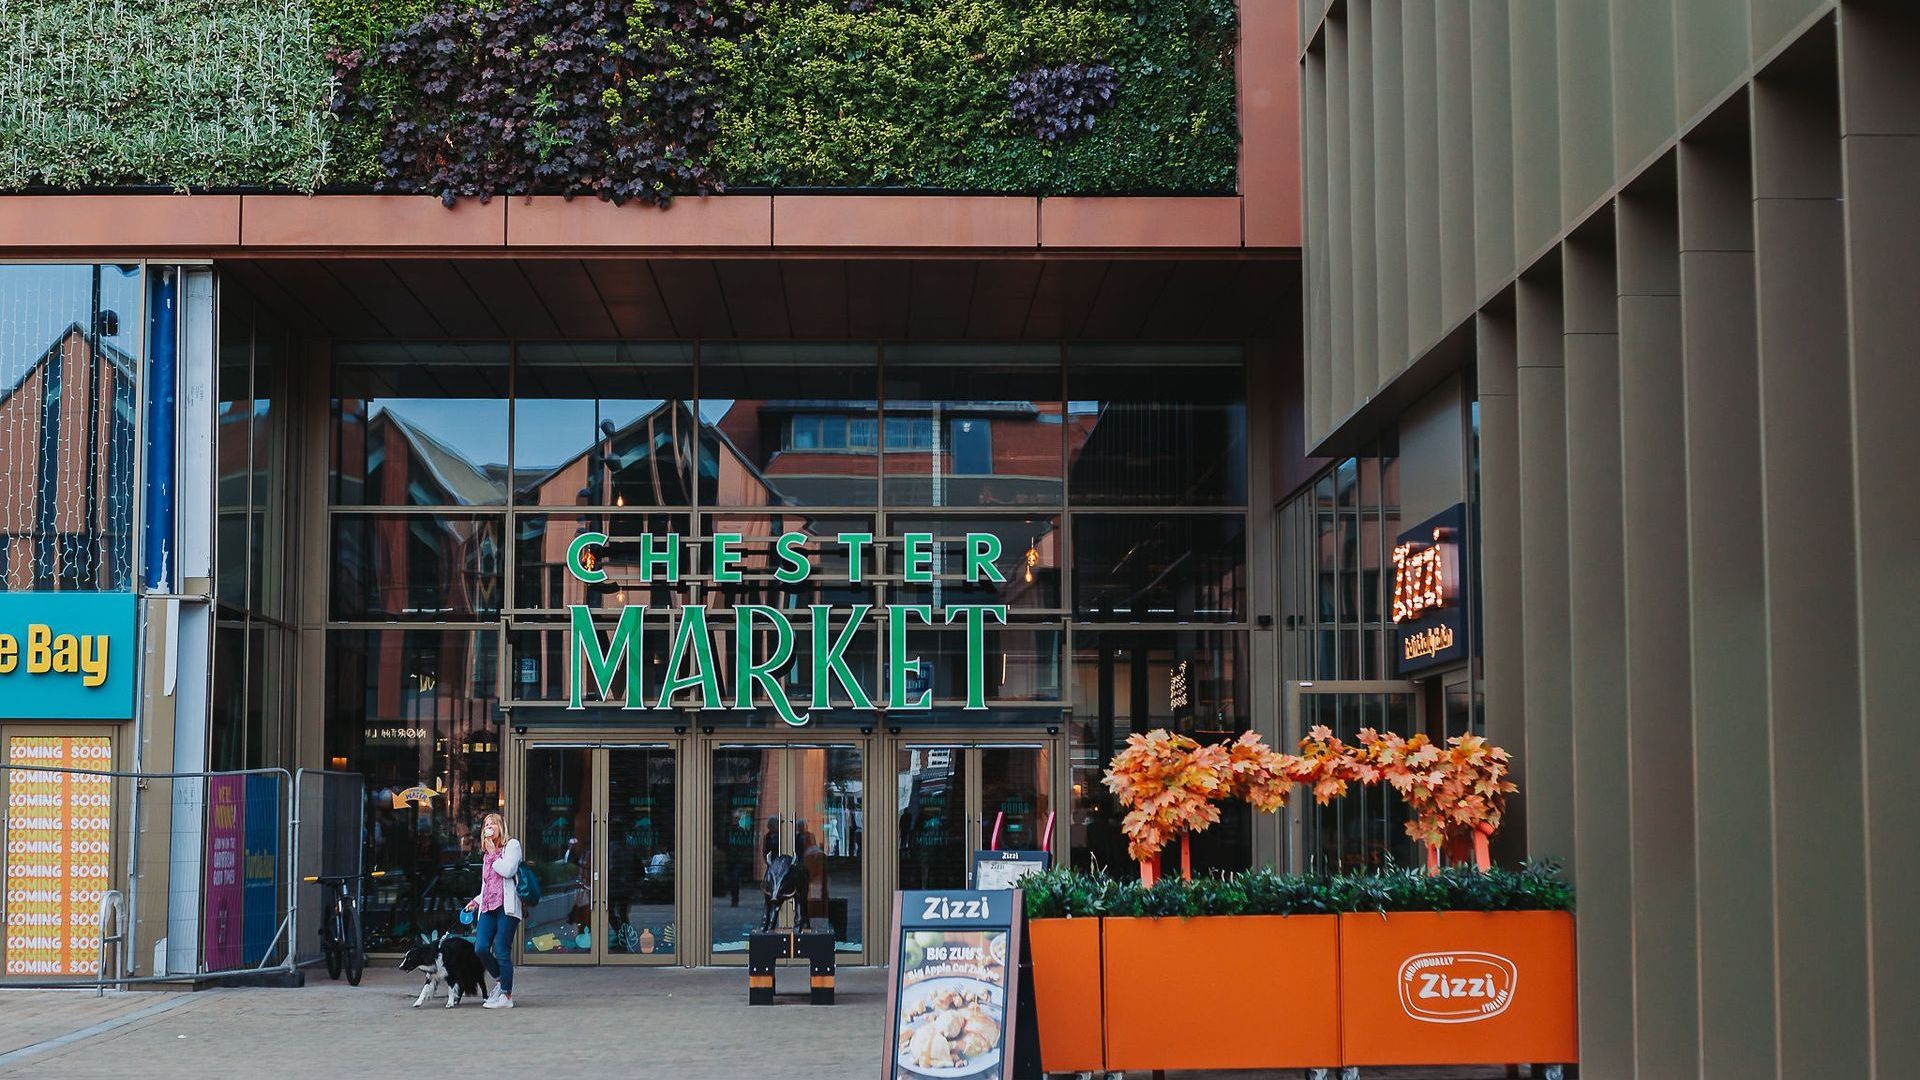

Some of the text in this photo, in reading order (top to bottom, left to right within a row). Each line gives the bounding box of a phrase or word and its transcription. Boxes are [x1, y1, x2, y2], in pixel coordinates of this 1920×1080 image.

[566, 531, 1007, 584] CHESTER
[1393, 526, 1443, 624] Zizzi
[27, 623, 109, 687] Bay
[566, 604, 1008, 726] MARKET
[10, 746, 111, 758] COMING SOON
[10, 770, 62, 783] COMING
[10, 794, 109, 806] COMING SOON
[9, 818, 108, 830] COMING SOON
[9, 841, 108, 853] COMING SOON
[9, 865, 107, 878] COMING SOON
[8, 890, 100, 902] COMING SOO
[922, 896, 990, 920] Zizzi
[8, 914, 99, 926] COMING SOO
[8, 937, 99, 949] COMING SOO
[926, 947, 948, 961] BIG
[7, 961, 98, 972] COMING SOO
[925, 962, 952, 977] Apple
[1404, 956, 1455, 982] INDIVIDUALLY
[1418, 972, 1496, 999] Zizzi
[1481, 989, 1509, 1014] ITALIAN
